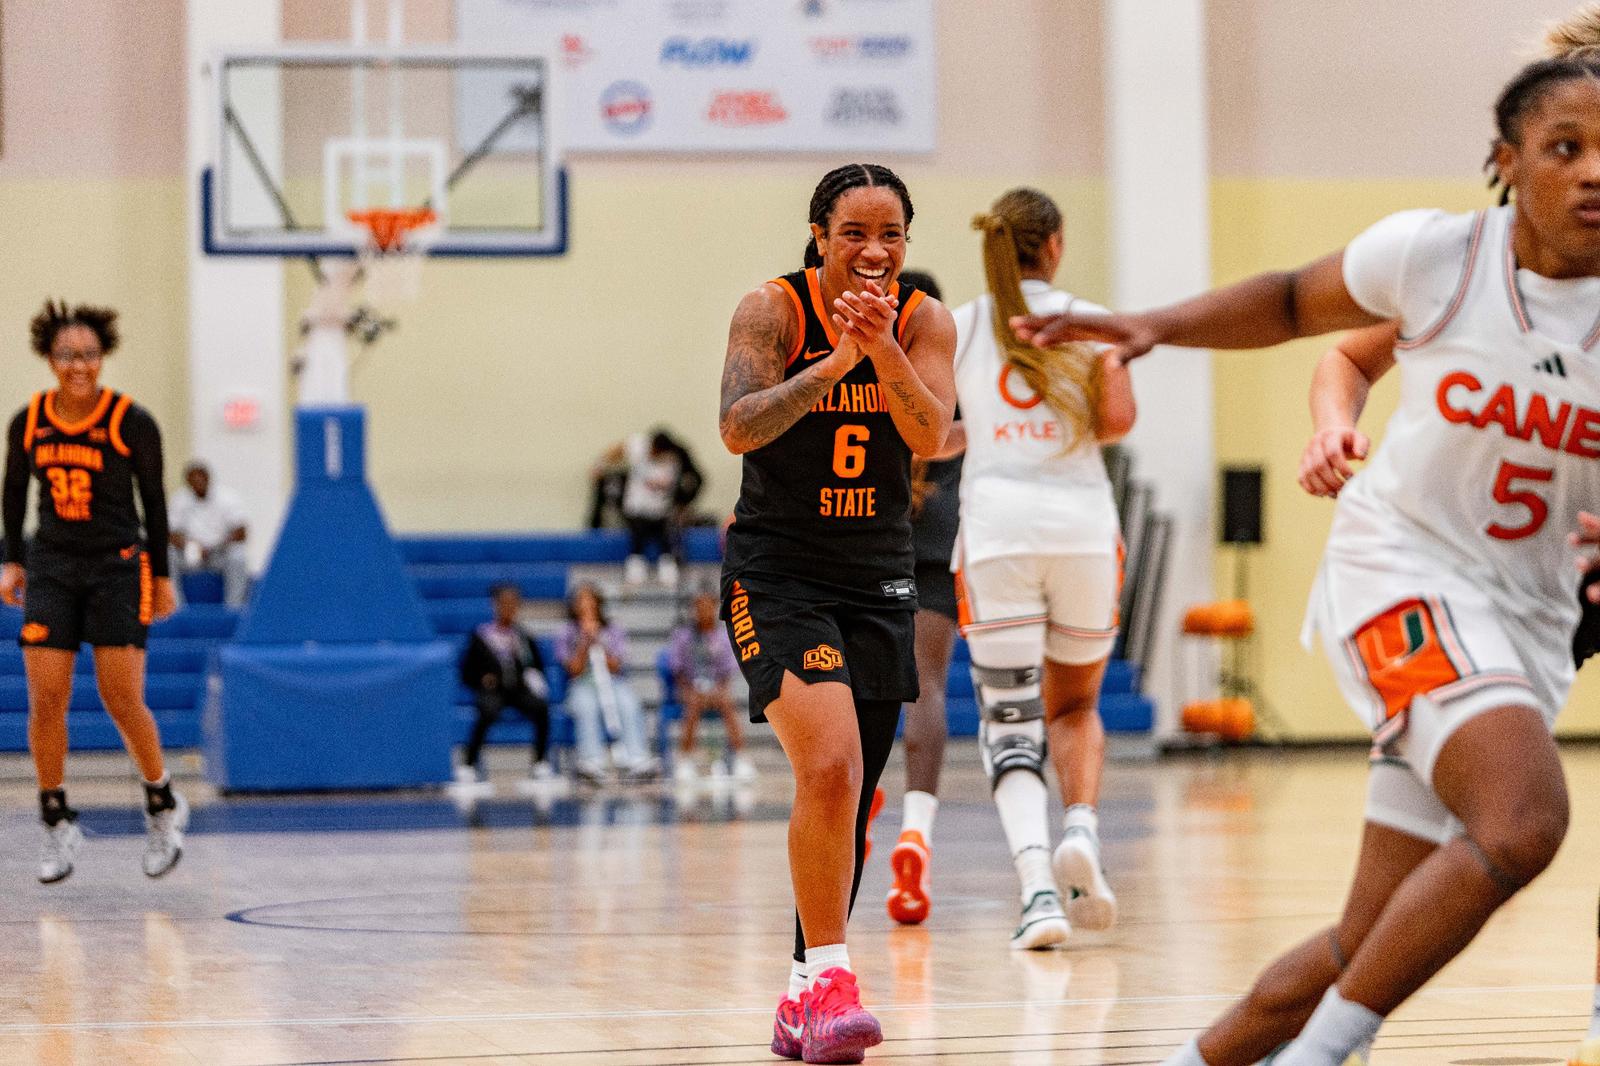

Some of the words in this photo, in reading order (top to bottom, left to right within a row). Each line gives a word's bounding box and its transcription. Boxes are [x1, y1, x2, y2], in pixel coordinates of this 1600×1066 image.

[994, 421, 1057, 442] KYLE
[832, 424, 870, 478] 6
[47, 467, 92, 501] 32
[1486, 459, 1554, 540] 5
[820, 487, 876, 517] STATE
